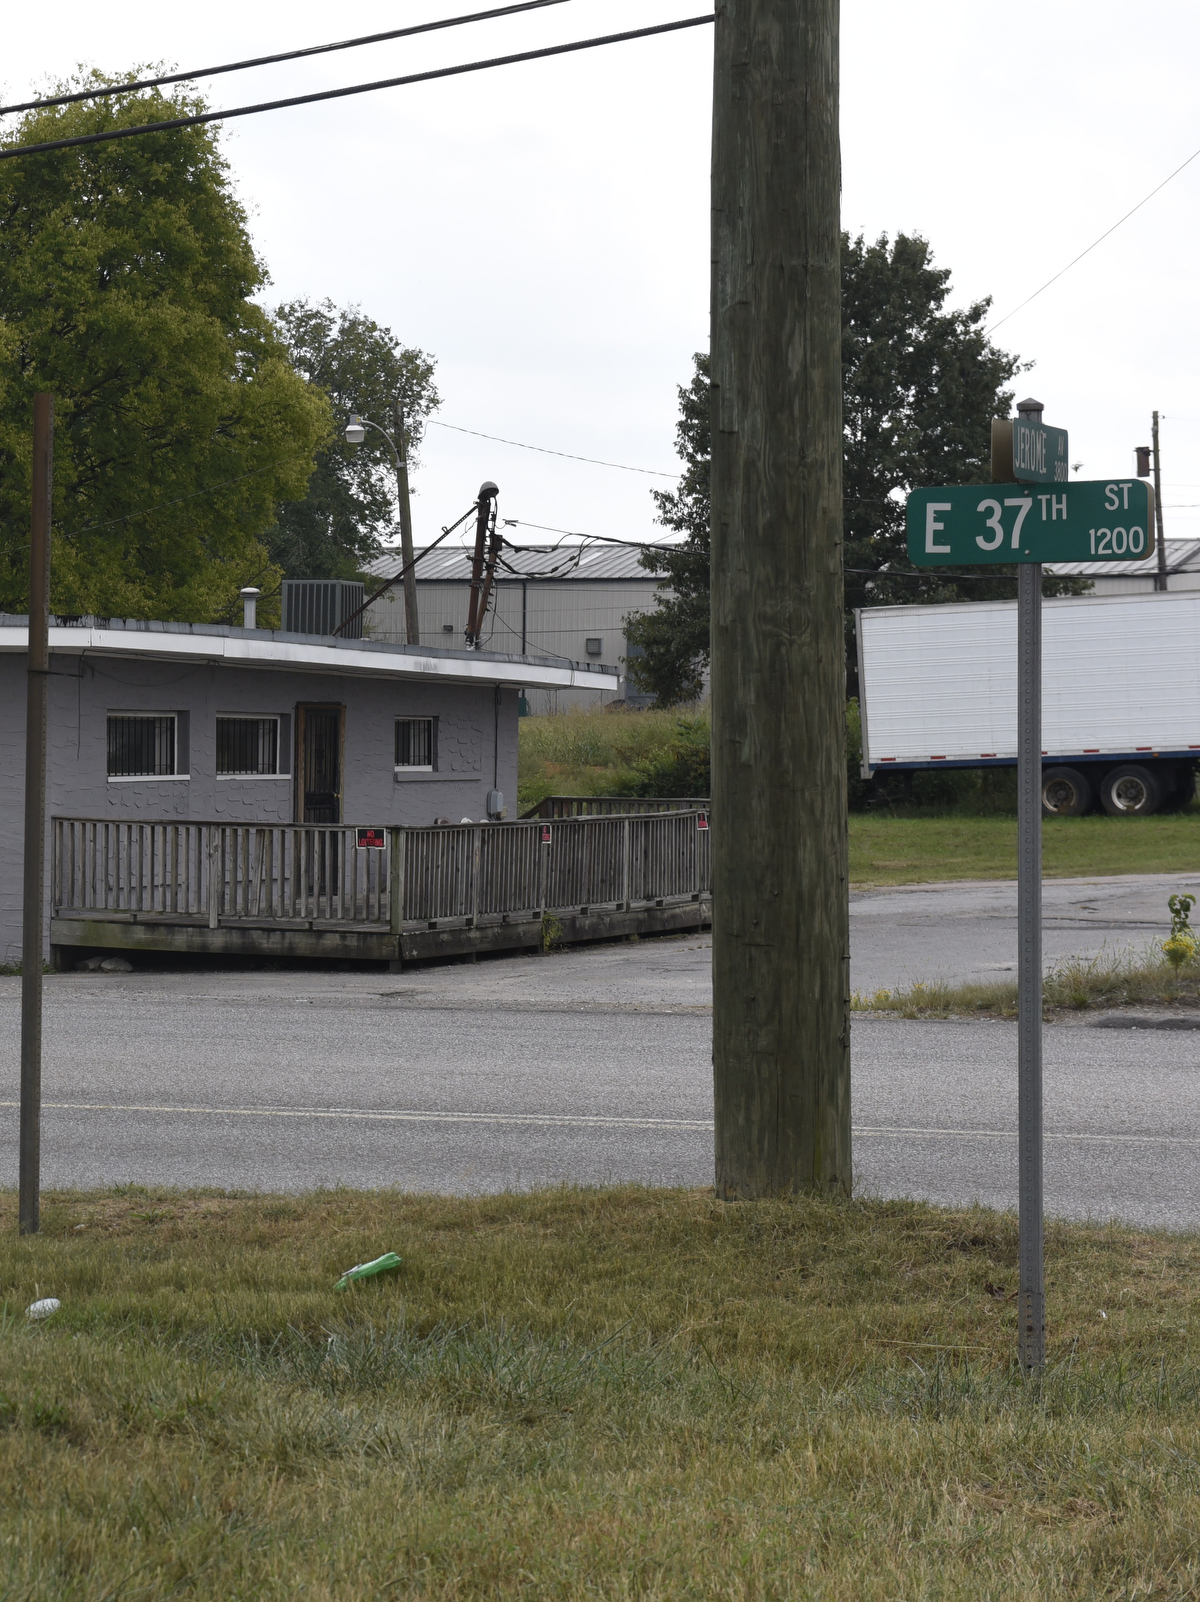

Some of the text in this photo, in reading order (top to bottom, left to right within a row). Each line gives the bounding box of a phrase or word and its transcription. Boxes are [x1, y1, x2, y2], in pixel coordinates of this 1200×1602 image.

[1015, 425, 1047, 474] JEROME
[925, 502, 952, 553] E
[1104, 483, 1133, 511] ST
[1088, 526, 1145, 555] 1200
[367, 830, 375, 838] NO
